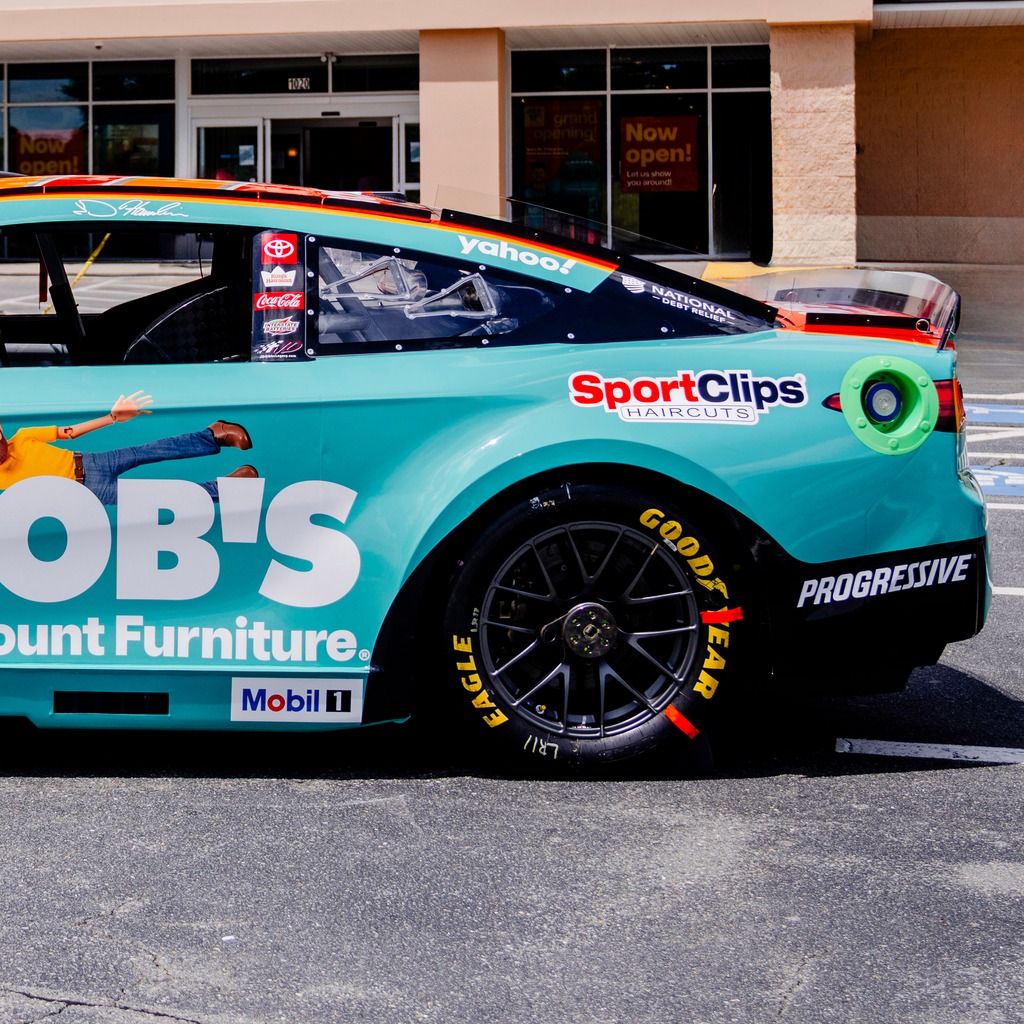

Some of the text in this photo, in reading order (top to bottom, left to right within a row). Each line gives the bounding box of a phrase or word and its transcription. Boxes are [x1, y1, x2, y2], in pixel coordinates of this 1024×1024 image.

[288, 78, 310, 90] 1020
[19, 135, 67, 154] Now
[626, 123, 678, 142] Now
[19, 156, 79, 175] open!
[626, 143, 692, 167] open!
[626, 180, 641, 188] you
[457, 235, 577, 275] yahoo!
[652, 285, 735, 320] NATIONAL
[662, 297, 726, 323] DEBT RELIEF
[626, 407, 750, 419] HAIRCUTS
[796, 553, 972, 608] PROGRESSIVE
[115, 615, 357, 662] Furniture
[453, 635, 509, 728] EAGLE
[242, 688, 320, 712] Mobil
